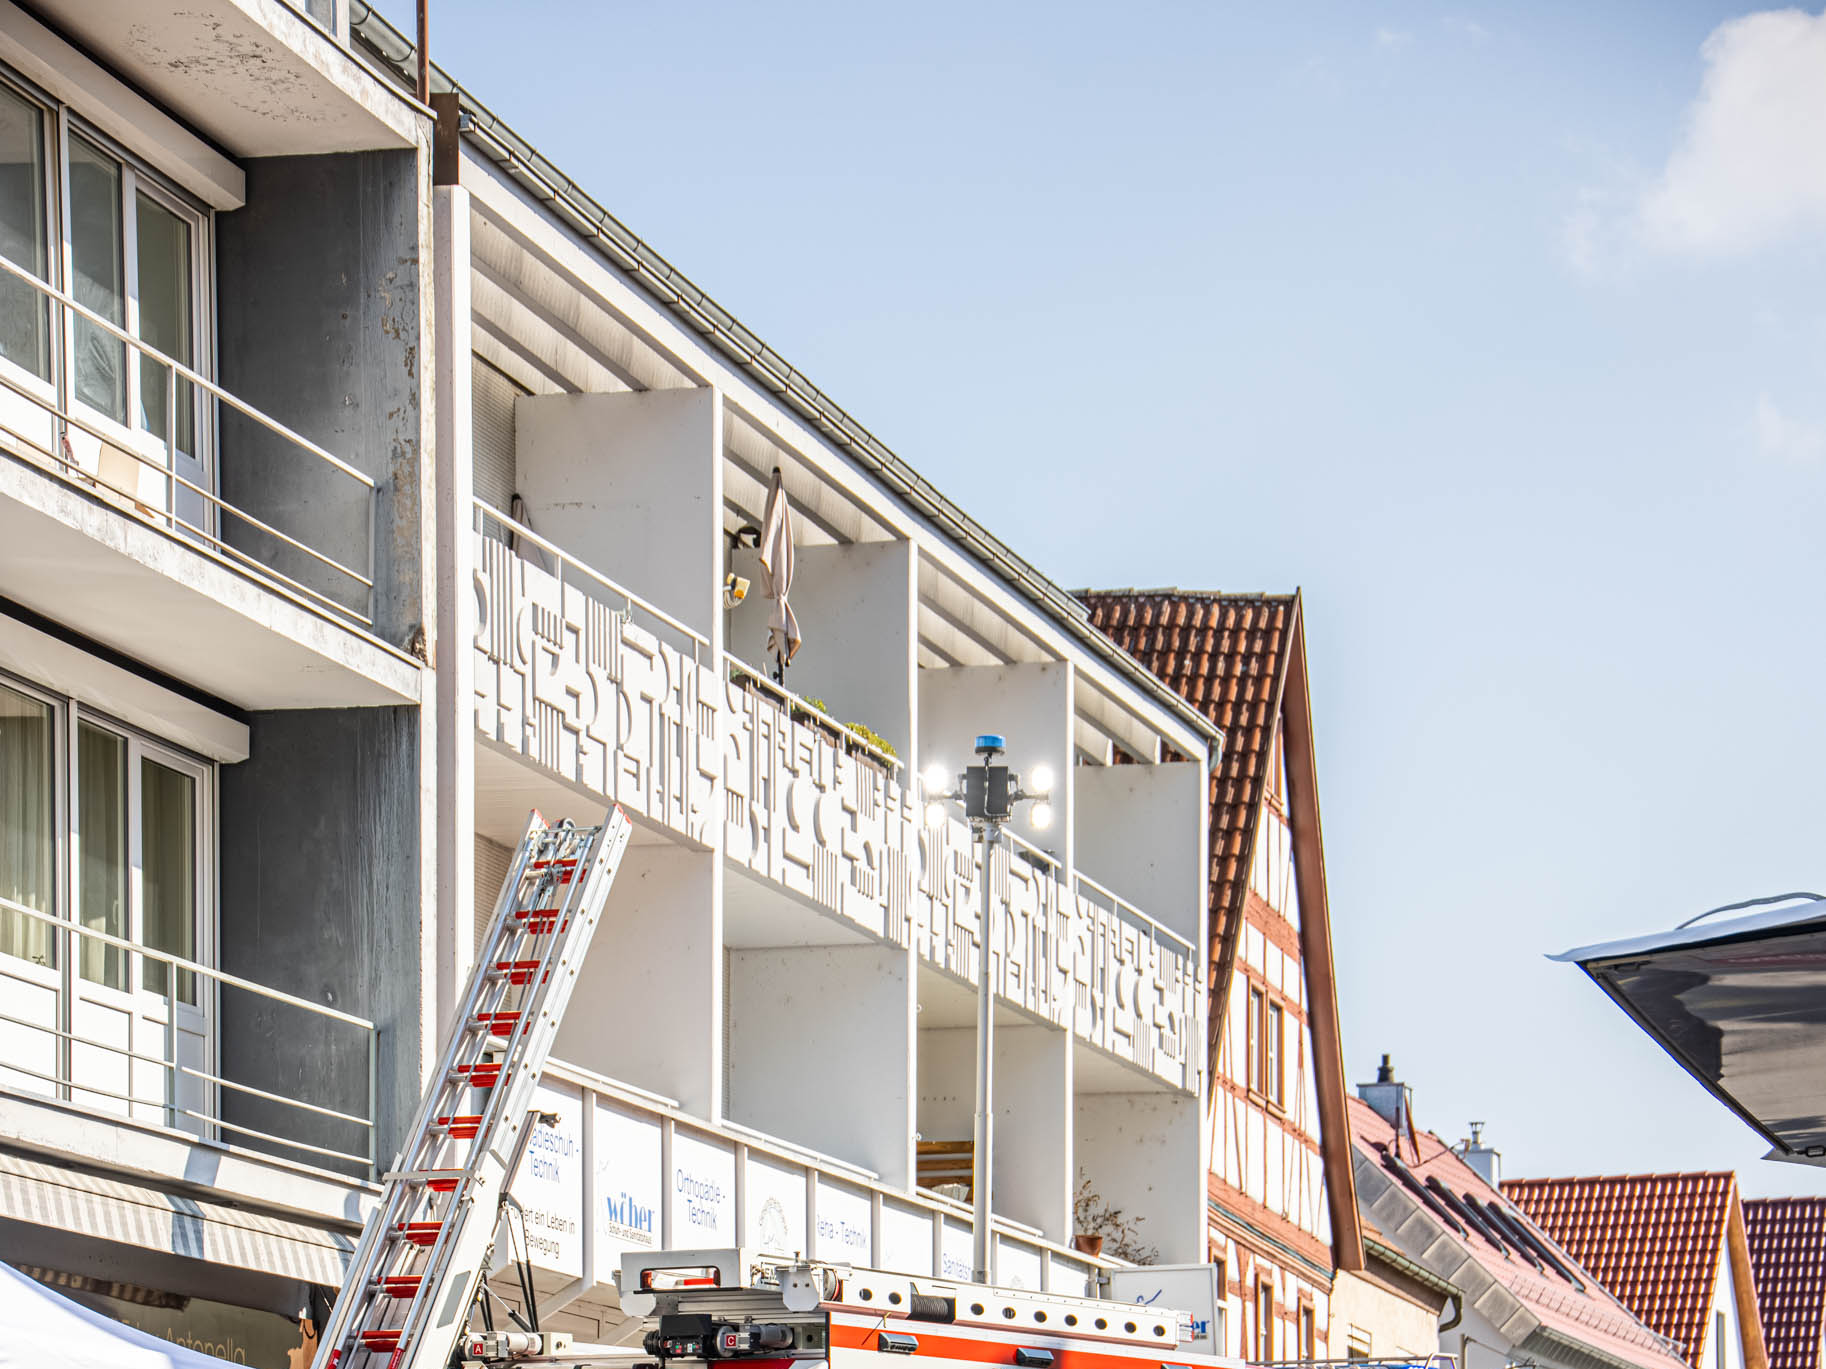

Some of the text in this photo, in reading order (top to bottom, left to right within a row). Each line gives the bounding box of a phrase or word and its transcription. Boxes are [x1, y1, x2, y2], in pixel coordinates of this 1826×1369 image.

[528, 1149, 560, 1184] Technik
[546, 1209, 567, 1232] Leben
[687, 1199, 717, 1231] Technik
[839, 1220, 867, 1249] Technik
[475, 1344, 482, 1354] A
[727, 1336, 735, 1346] C
